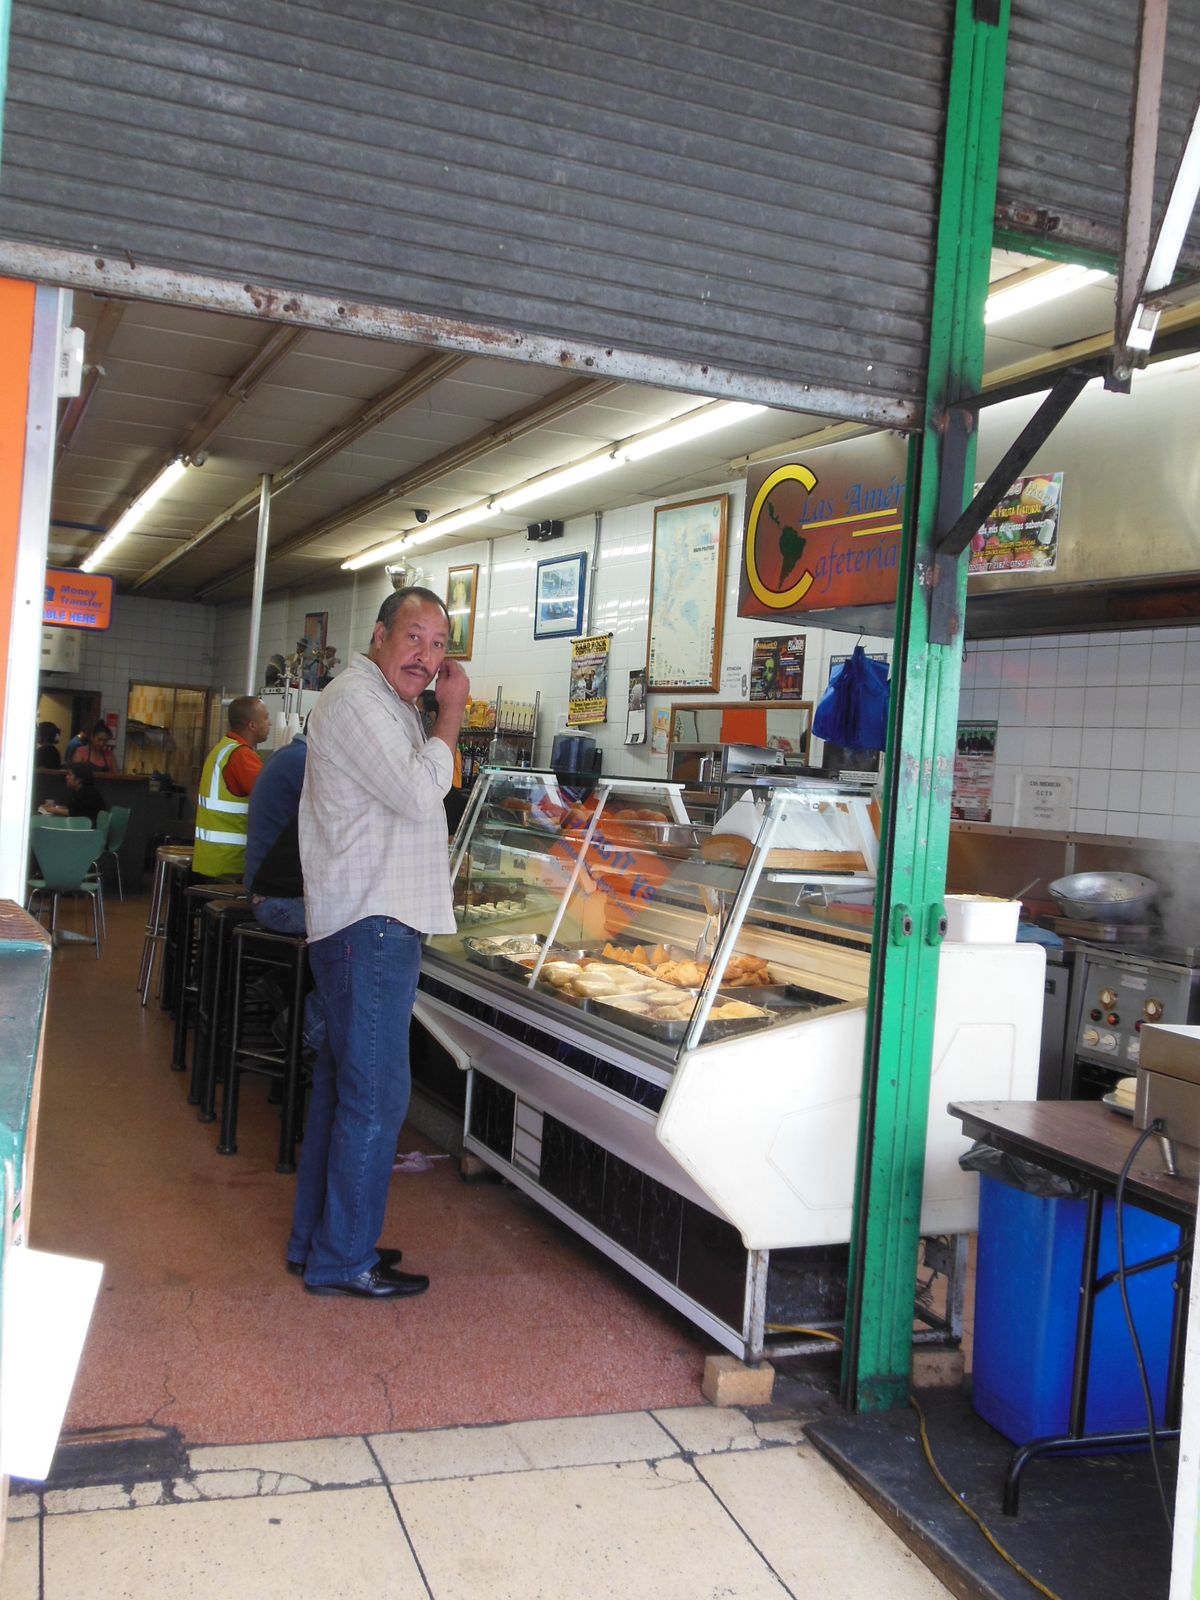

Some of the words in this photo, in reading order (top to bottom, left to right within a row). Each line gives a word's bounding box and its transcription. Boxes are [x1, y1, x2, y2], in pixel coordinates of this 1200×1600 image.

[61, 585, 97, 598] Money
[61, 596, 103, 609] Transfer
[70, 612, 97, 625] HERE
